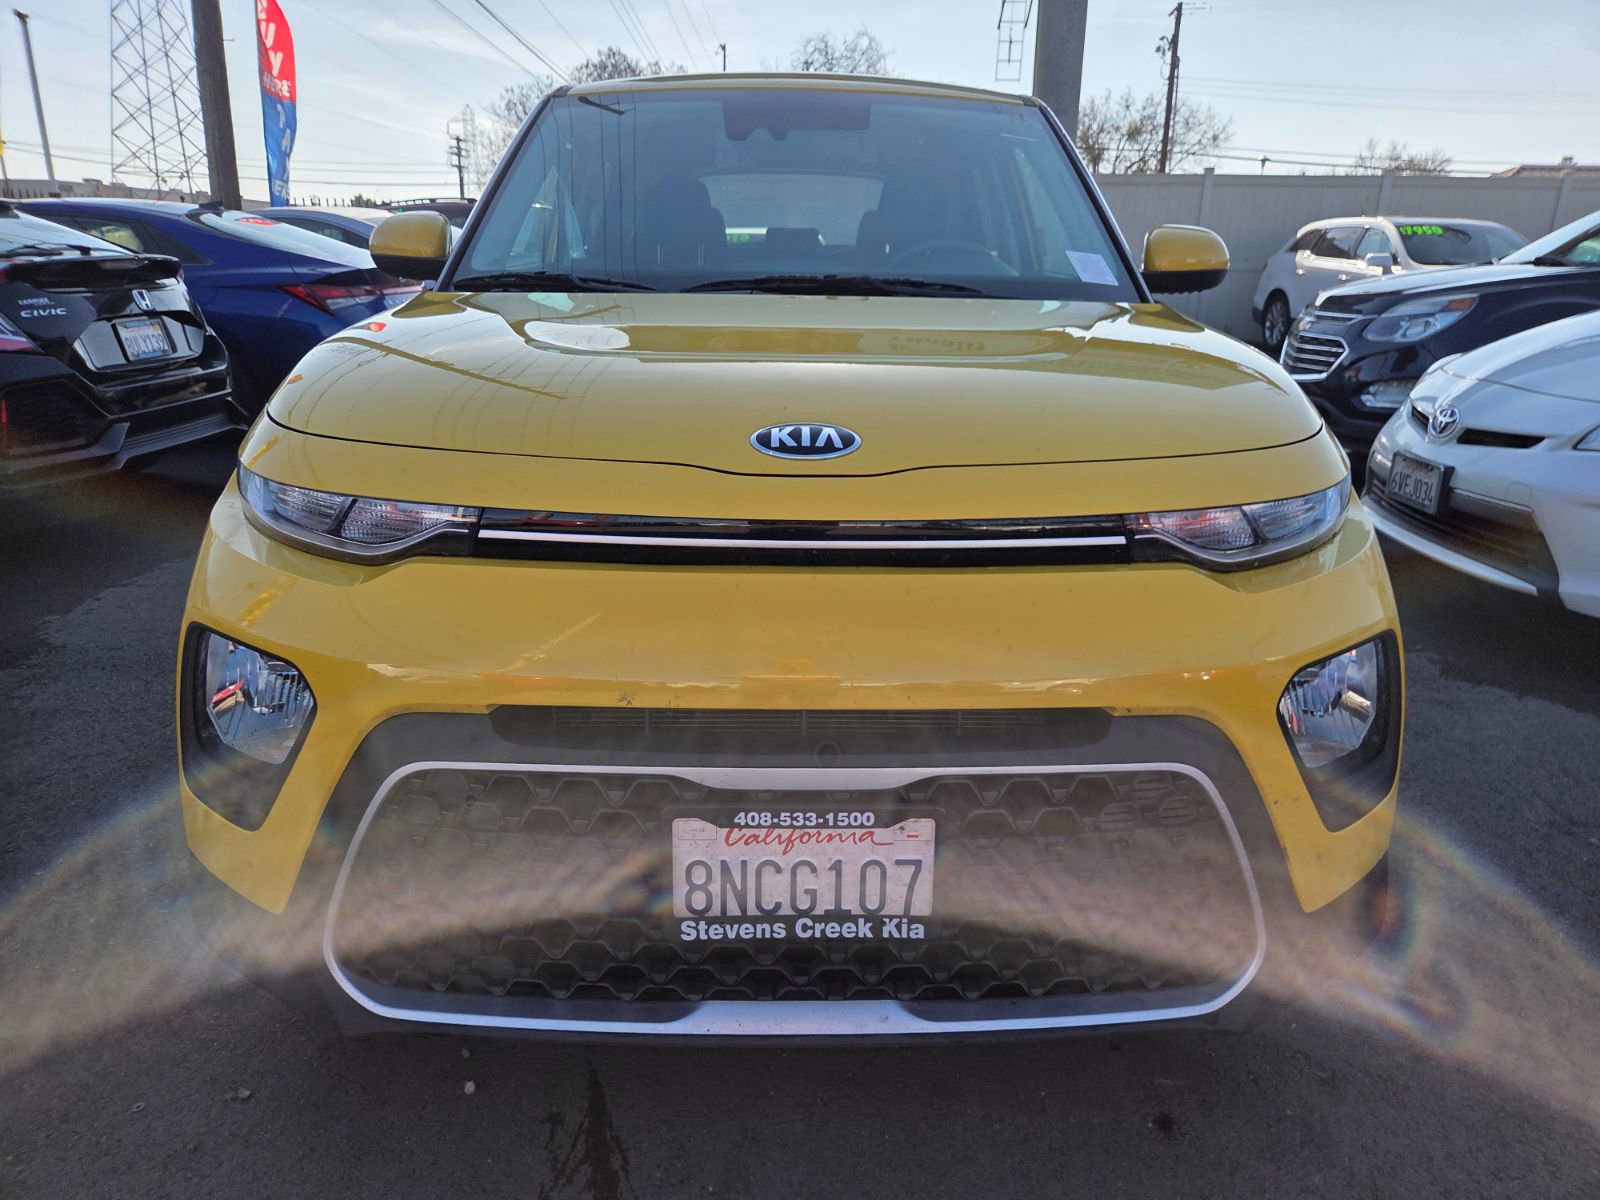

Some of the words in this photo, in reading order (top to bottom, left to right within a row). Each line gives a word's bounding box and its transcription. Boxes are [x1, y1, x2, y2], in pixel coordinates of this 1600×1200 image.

[20, 308, 67, 318] CIVIC
[770, 426, 844, 448] KIA
[734, 812, 875, 826] 408-533-1500
[724, 827, 893, 855] California
[684, 859, 923, 916] 8NCG107
[680, 919, 787, 941] Stevens
[795, 918, 874, 938] Creek
[882, 918, 925, 939] Kia
